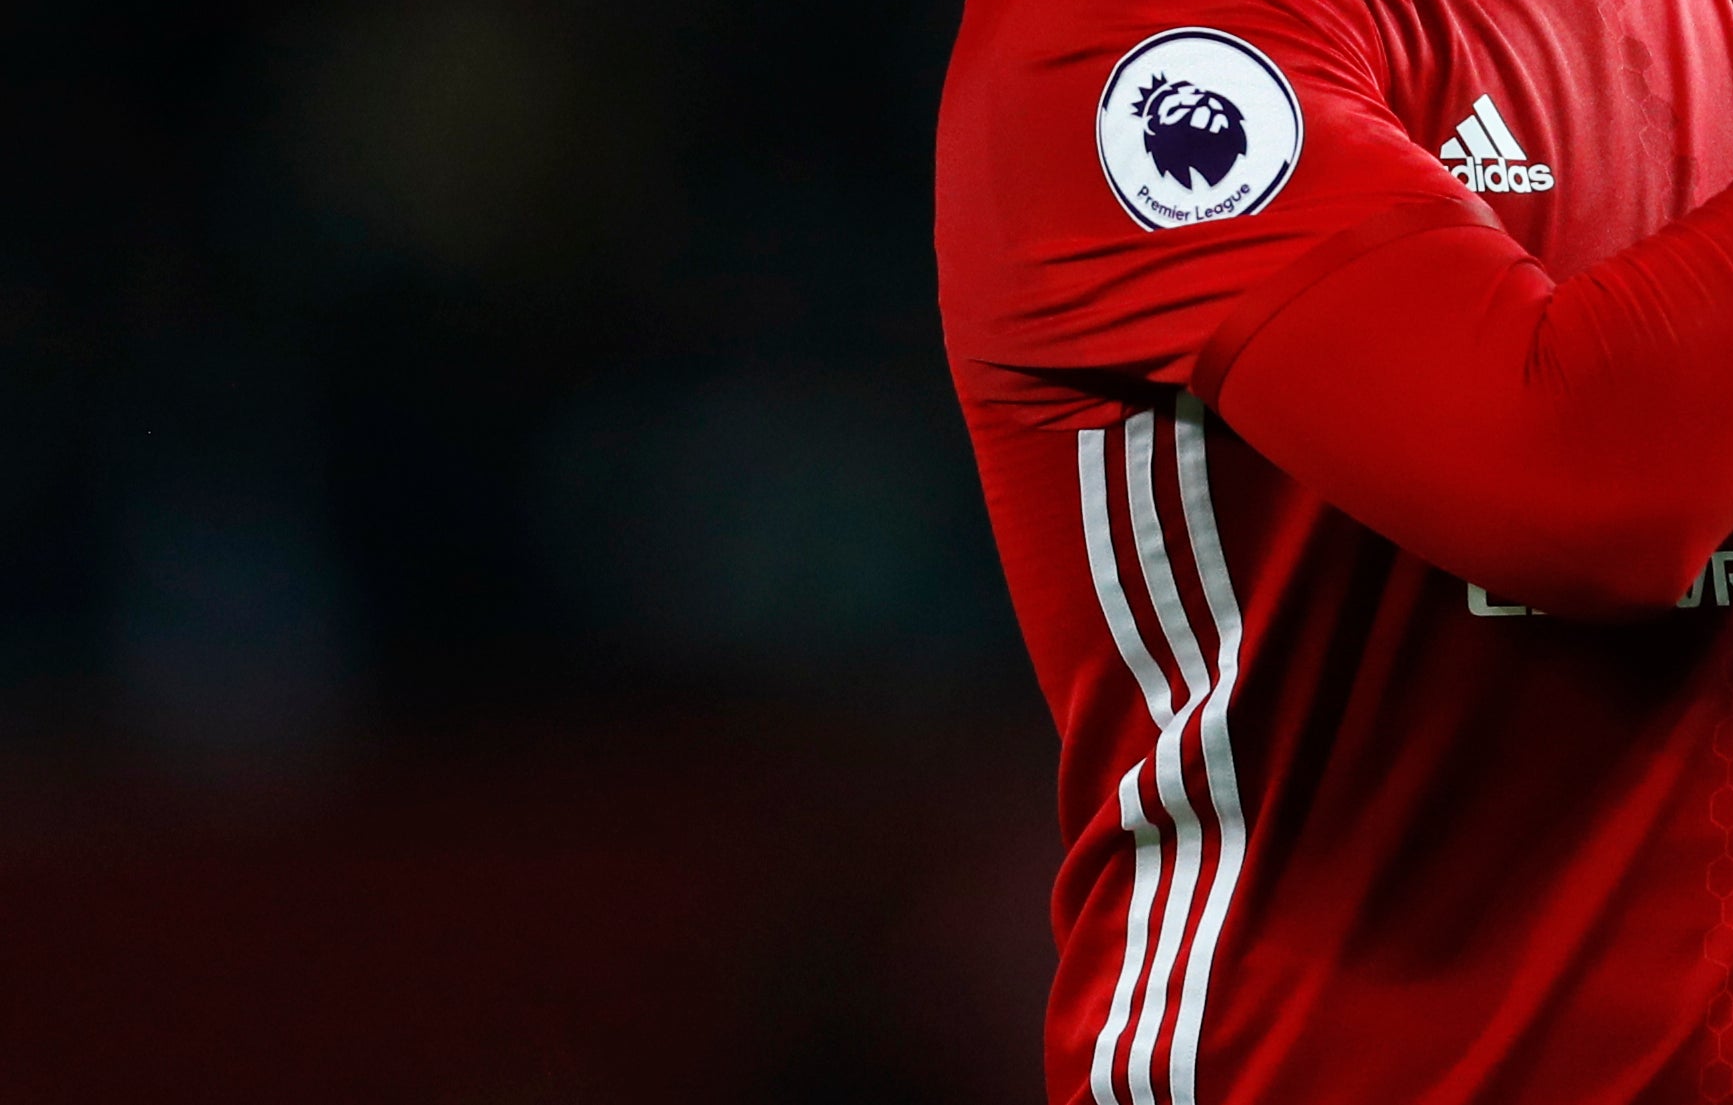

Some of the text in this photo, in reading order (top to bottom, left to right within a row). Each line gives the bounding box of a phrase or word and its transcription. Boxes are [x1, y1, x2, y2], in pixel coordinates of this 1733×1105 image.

[1443, 156, 1555, 193] didas
[1137, 183, 1250, 221] Premier League
